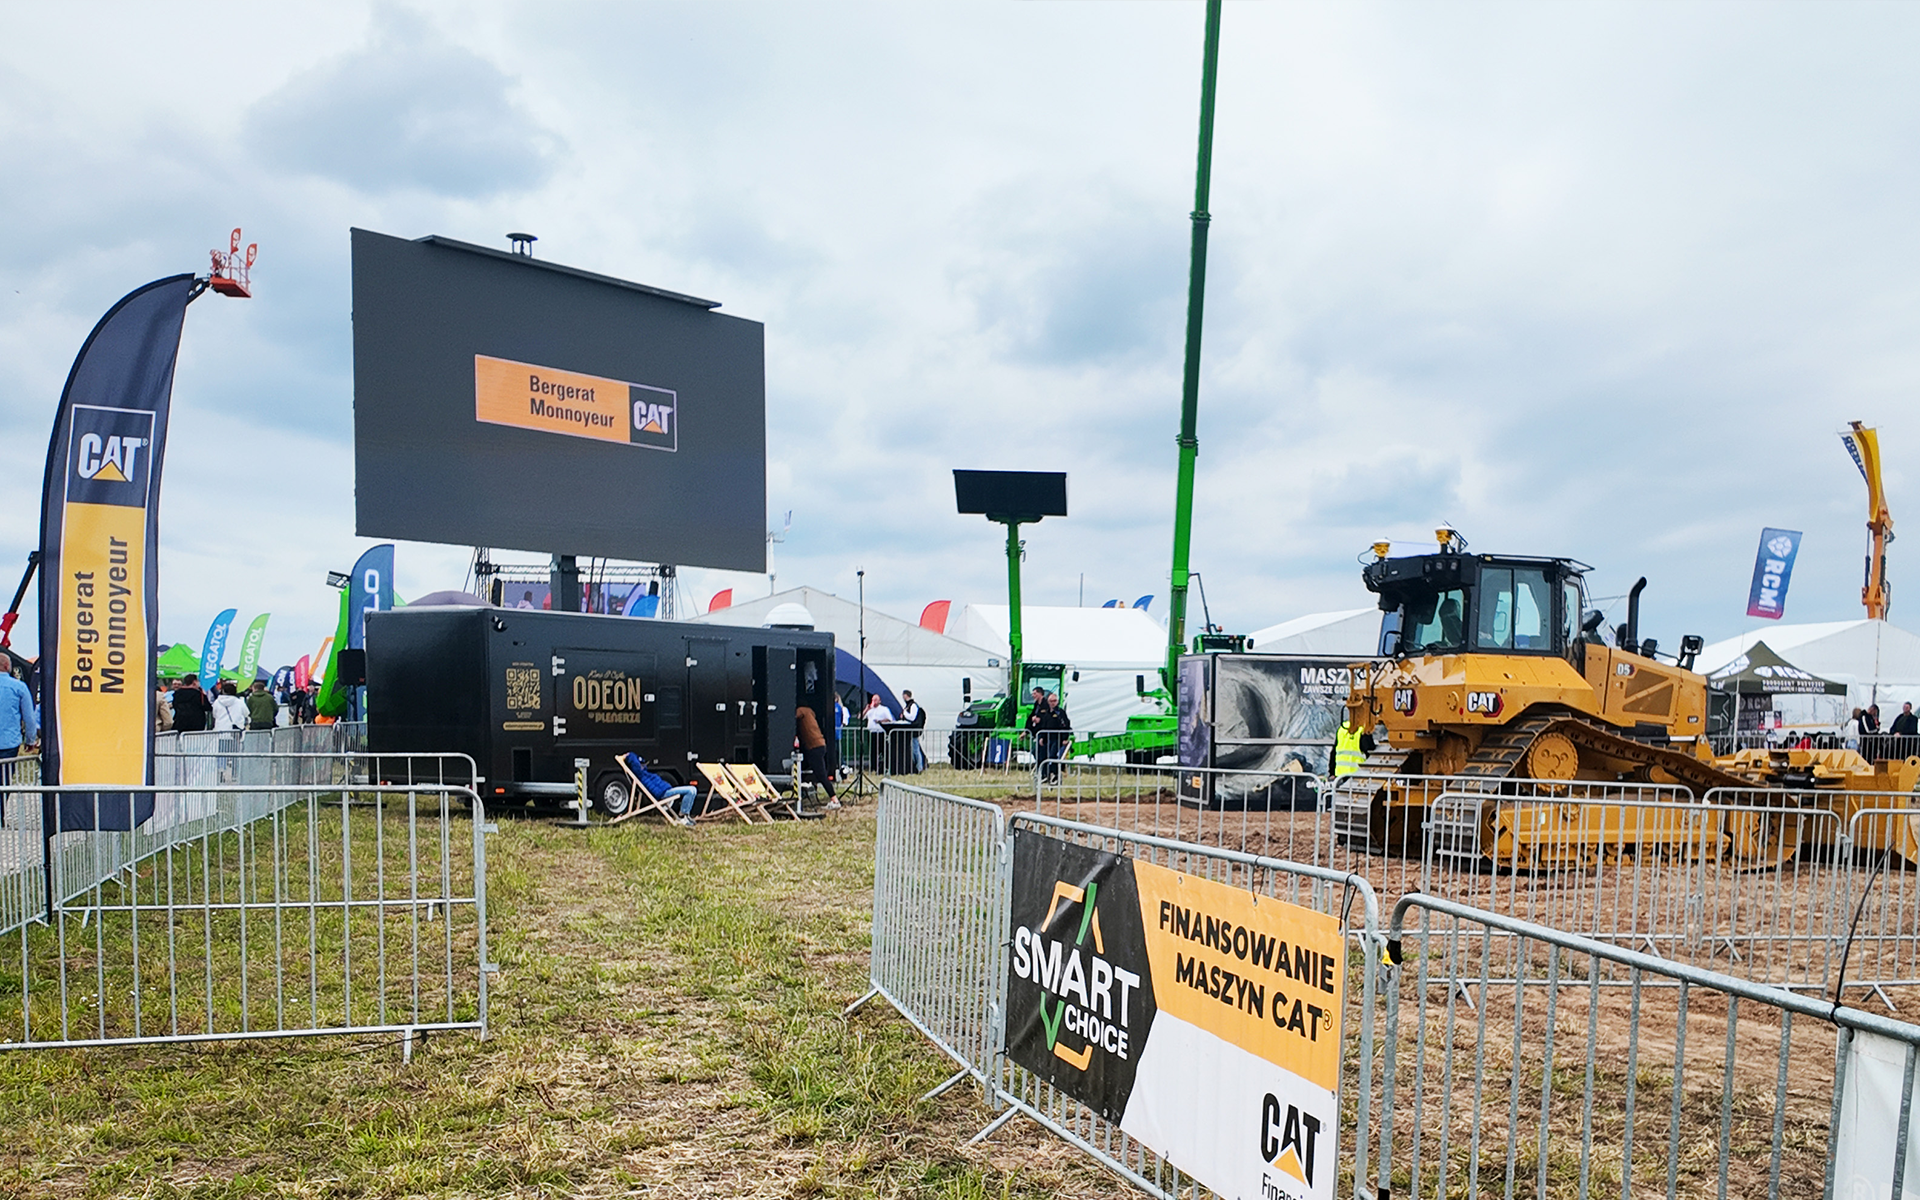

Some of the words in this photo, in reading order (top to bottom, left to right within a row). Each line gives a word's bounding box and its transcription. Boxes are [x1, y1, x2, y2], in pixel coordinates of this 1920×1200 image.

[530, 375, 595, 403] Bergerat
[530, 398, 615, 428] Monnoyeur
[633, 400, 673, 434] CAT
[1758, 559, 1786, 607] RCM
[71, 570, 97, 694] Bergerat
[99, 536, 131, 694] Monnoyeur
[204, 623, 227, 679] VEGATOL
[243, 627, 264, 678] VEGATOL
[1617, 662, 1631, 676] D5
[573, 675, 641, 710] ODEON
[1394, 689, 1413, 711] CAT
[1468, 691, 1496, 713] CAT
[1159, 900, 1335, 994] FINANSOWANIE
[1013, 926, 1140, 1028] SMART
[1175, 952, 1264, 1019] MASZYN
[1064, 1007, 1128, 1060] CHOICE
